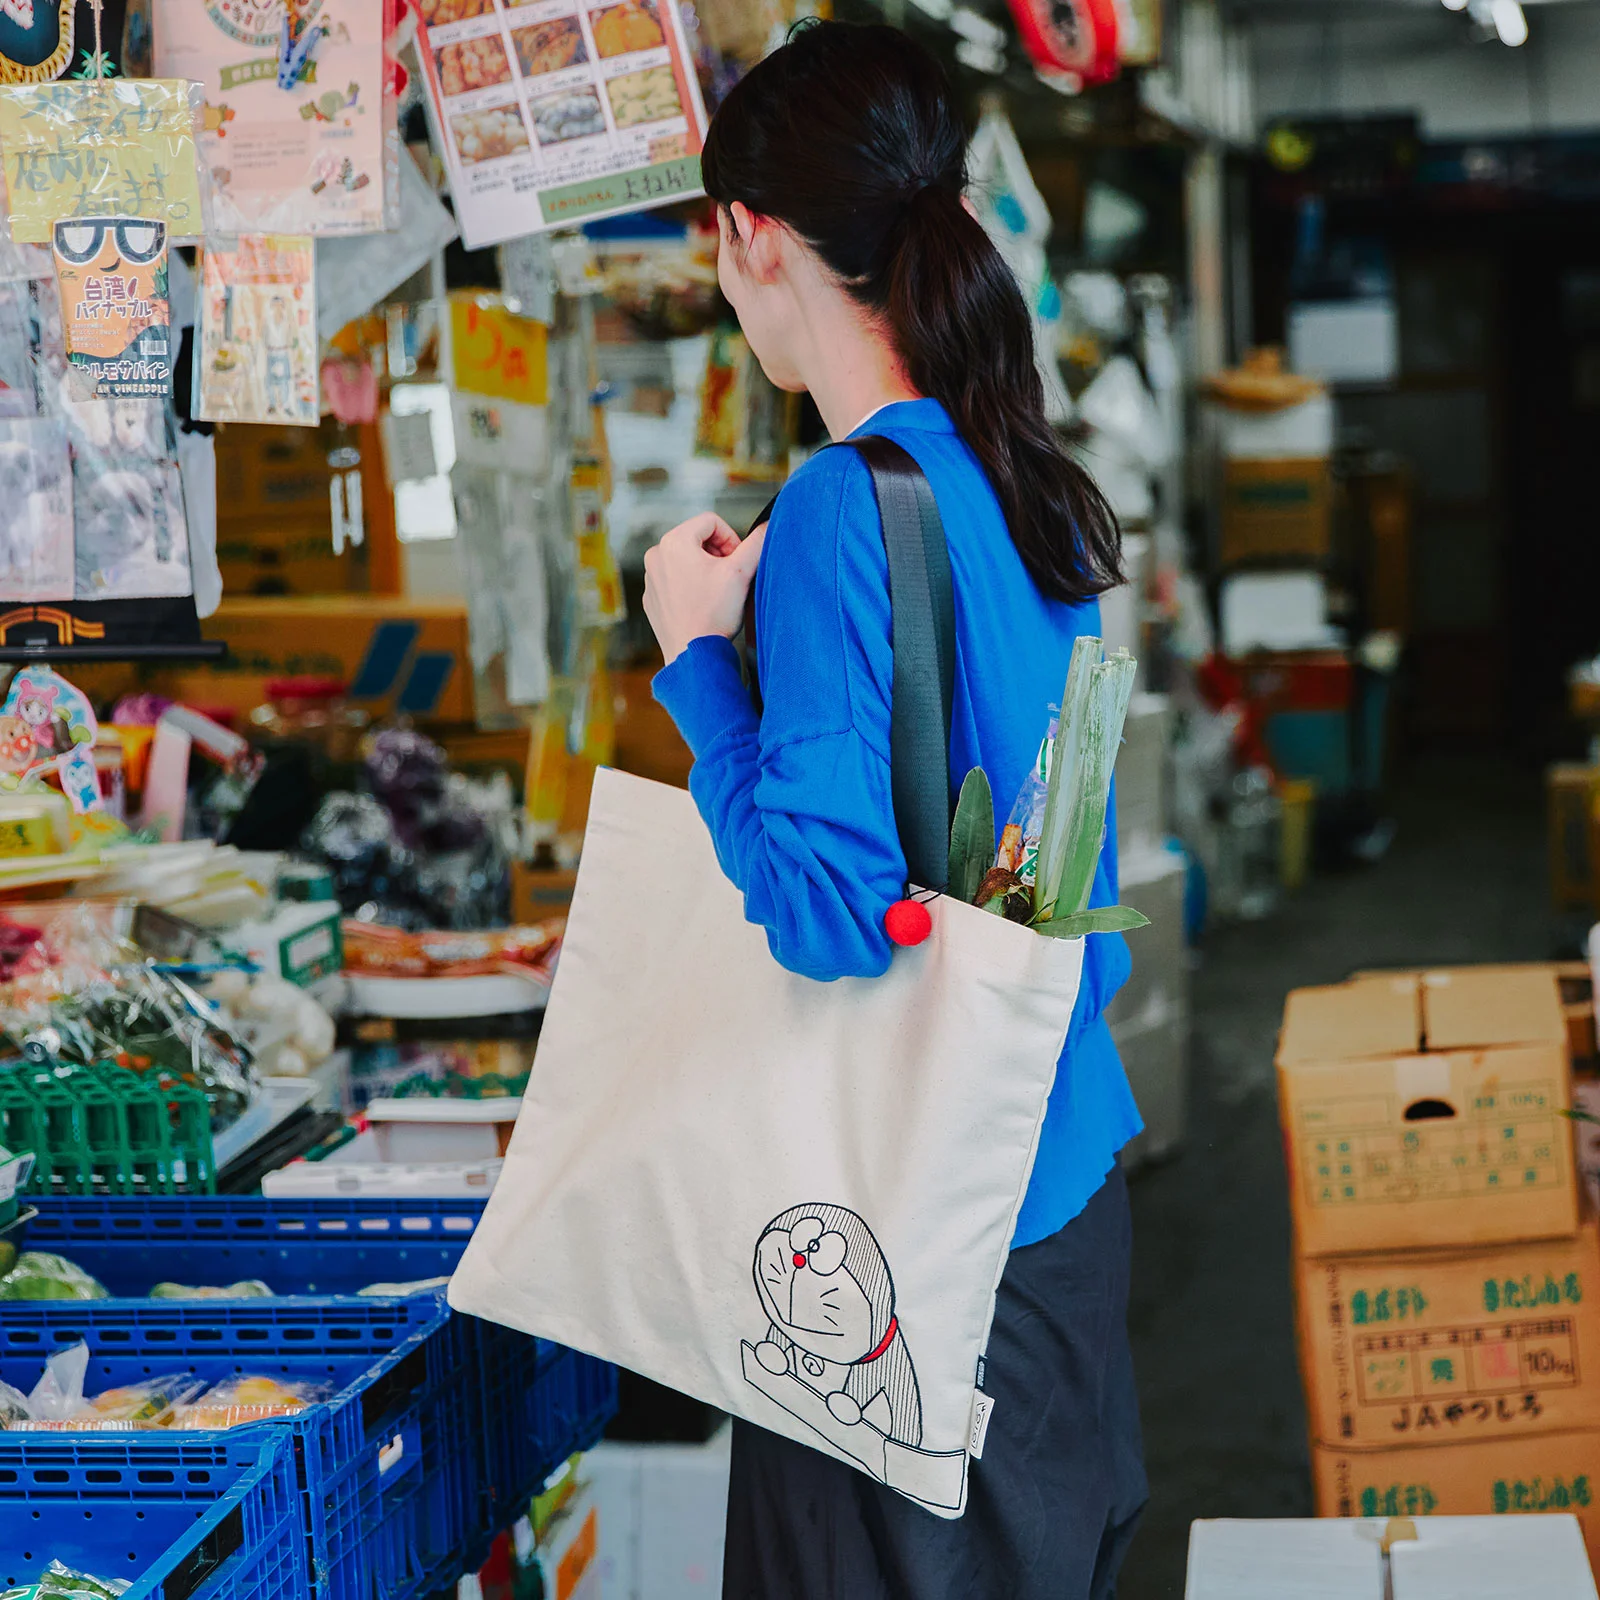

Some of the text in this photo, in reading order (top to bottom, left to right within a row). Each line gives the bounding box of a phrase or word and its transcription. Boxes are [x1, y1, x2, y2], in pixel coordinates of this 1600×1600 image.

[75, 299, 153, 321] パイナップル
[1390, 1391, 1543, 1432] JAやつしろ
